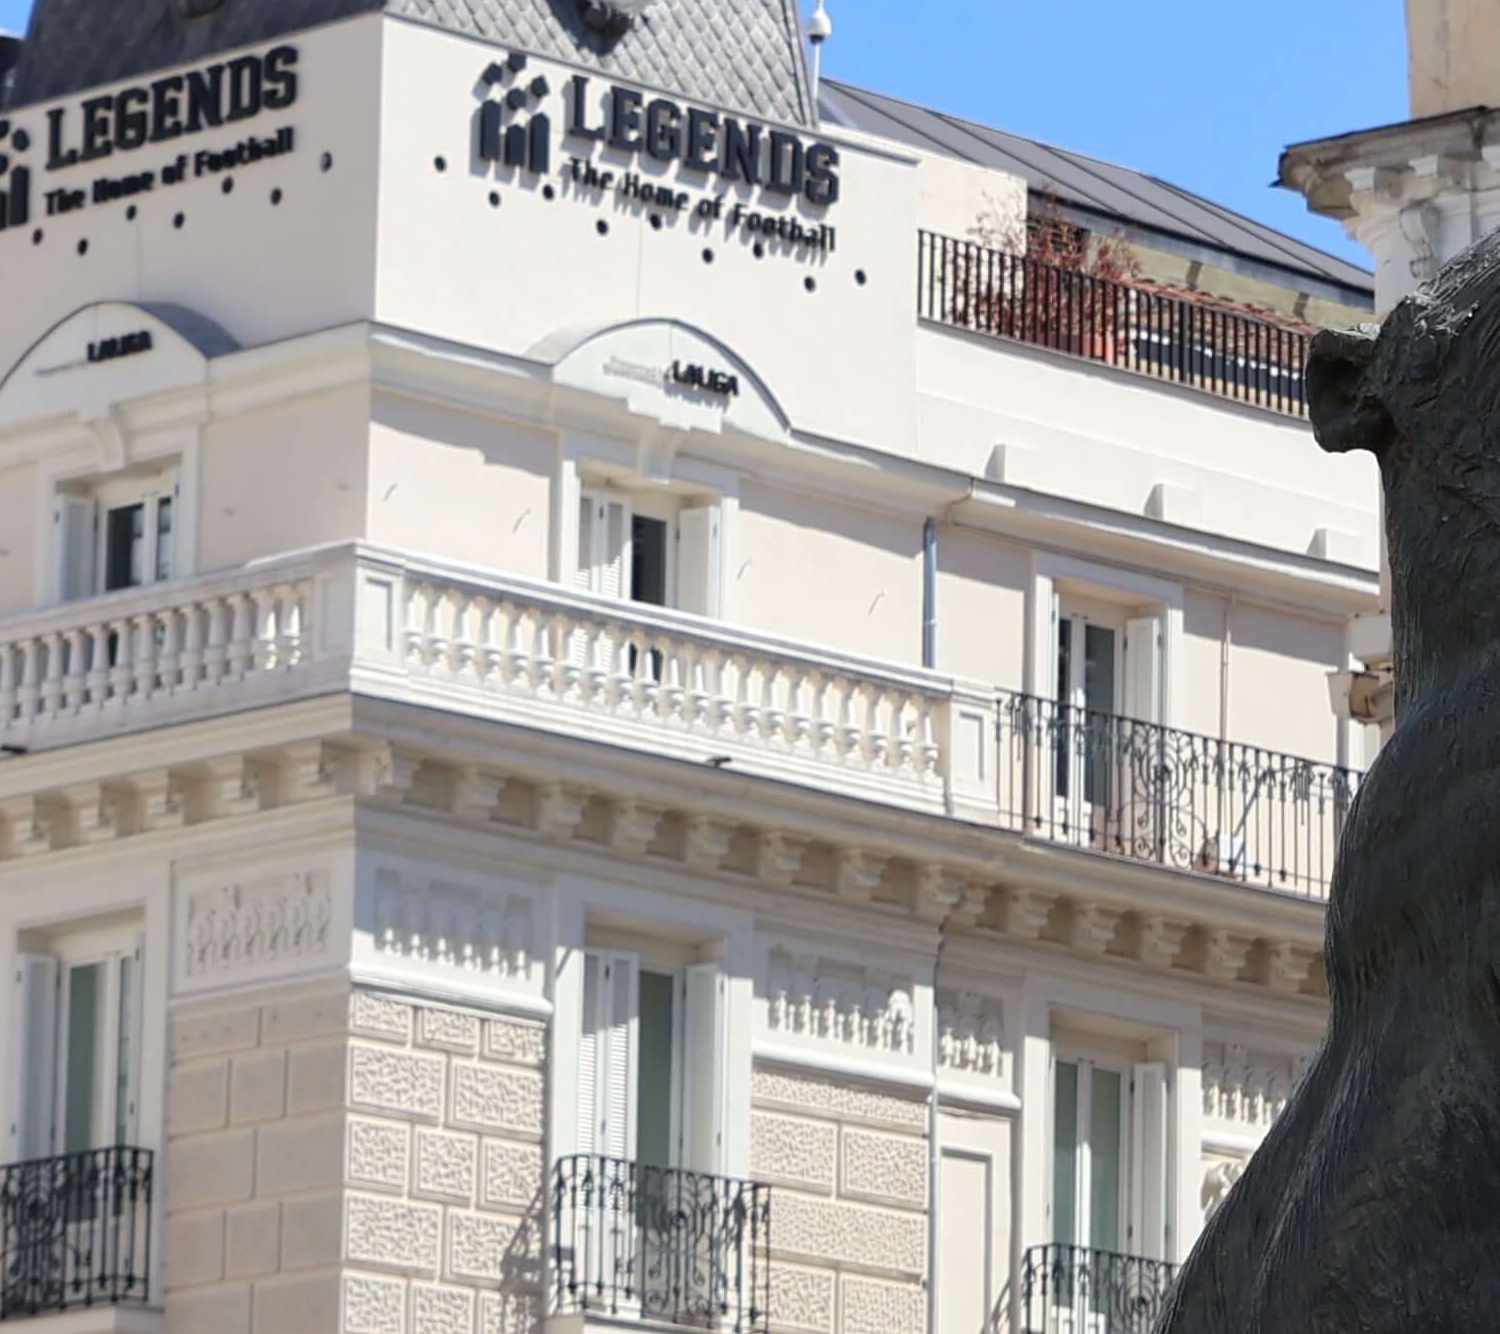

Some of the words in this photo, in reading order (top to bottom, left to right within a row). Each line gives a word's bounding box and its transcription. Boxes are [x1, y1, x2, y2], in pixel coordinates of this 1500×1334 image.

[45, 45, 298, 171] LEGENDS
[568, 73, 839, 205] LEGENDS
[44, 187, 86, 216] The
[92, 171, 155, 204] Home
[161, 154, 187, 185] of
[194, 126, 294, 177] Football
[569, 156, 615, 190] The
[621, 169, 690, 213] Home
[698, 193, 722, 220] of
[733, 201, 837, 253] Football
